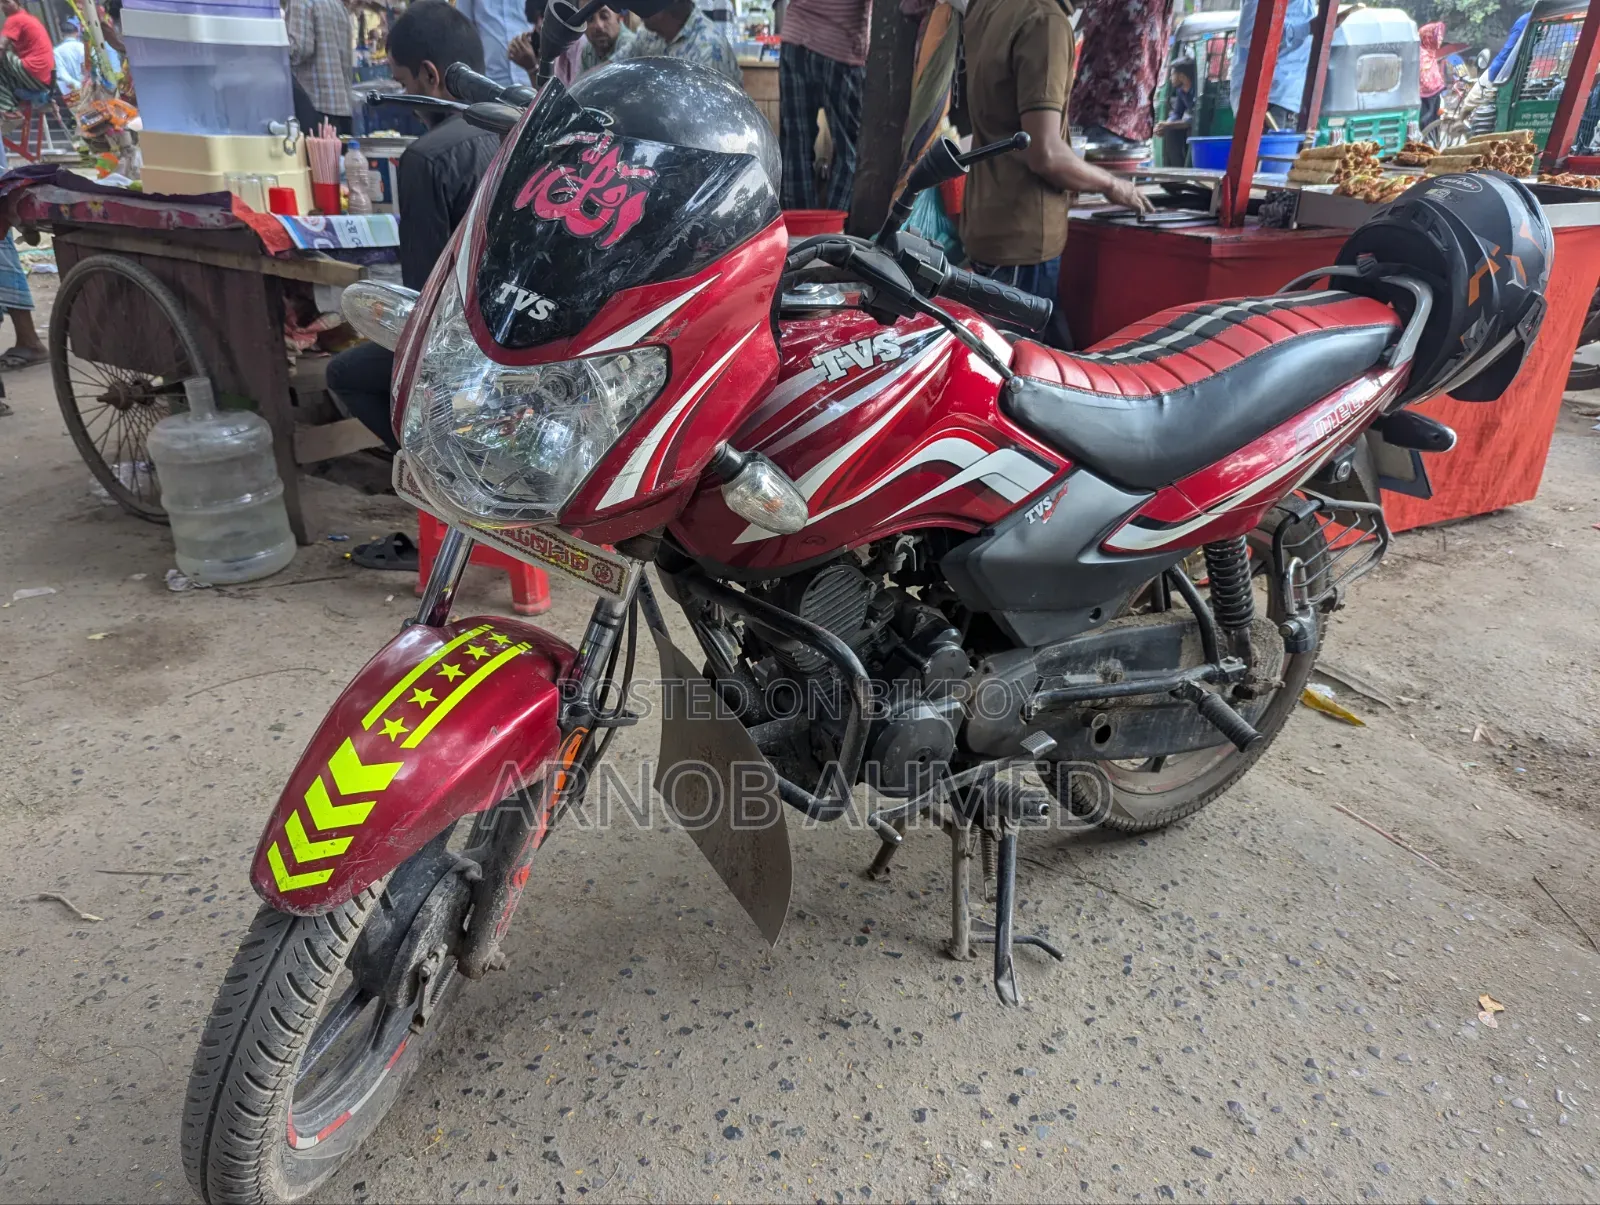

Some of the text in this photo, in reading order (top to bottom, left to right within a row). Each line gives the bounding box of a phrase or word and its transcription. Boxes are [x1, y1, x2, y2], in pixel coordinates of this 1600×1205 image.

[495, 282, 556, 321] TVS
[811, 331, 902, 383] TVS
[1024, 495, 1053, 524] TVS
